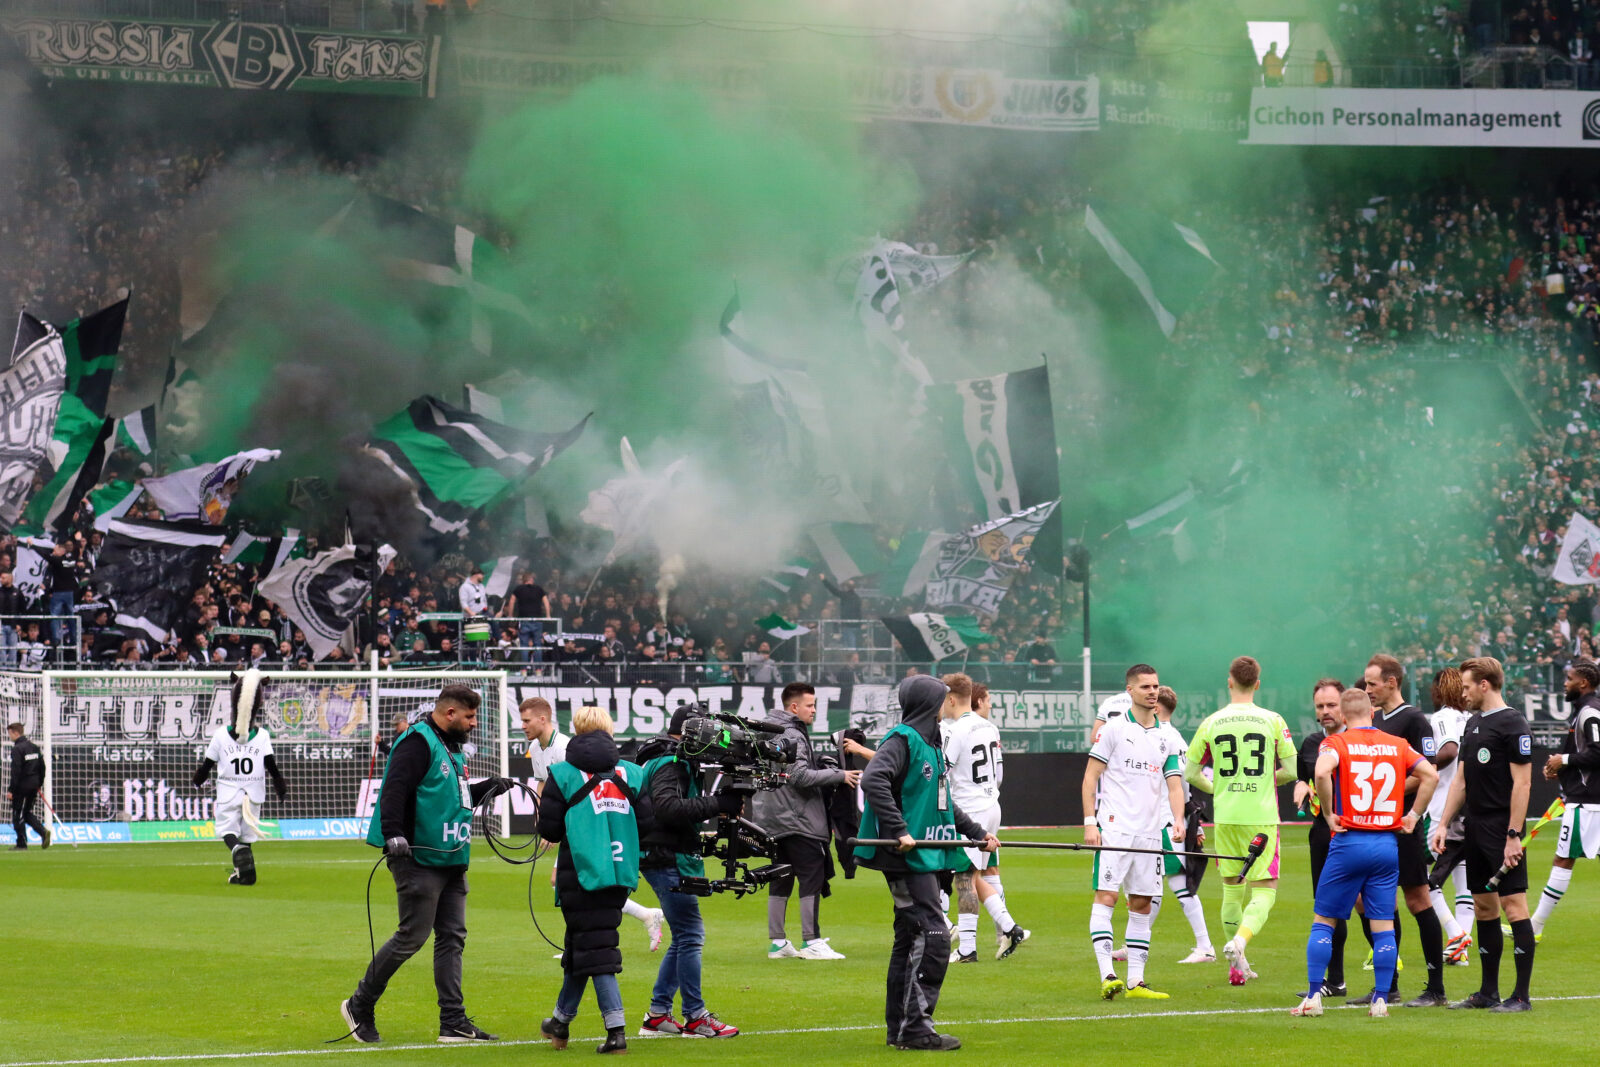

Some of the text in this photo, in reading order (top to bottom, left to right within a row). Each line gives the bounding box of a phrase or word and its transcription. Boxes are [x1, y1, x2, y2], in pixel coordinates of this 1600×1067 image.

[308, 36, 425, 81] FANS
[1003, 80, 1088, 114] JUNGS
[1253, 105, 1562, 132] Cichon Personalmanagement
[92, 746, 155, 763] flatex
[223, 745, 260, 757] JÜNTER
[292, 744, 354, 761] flatex
[1214, 733, 1266, 777] 33
[1347, 743, 1398, 757] DARMSTADT
[230, 757, 254, 775] 10
[1124, 758, 1160, 773] flatex
[1349, 761, 1397, 813] 32
[289, 828, 318, 838] www.
[1560, 825, 1570, 842] 3
[610, 841, 624, 862] 2
